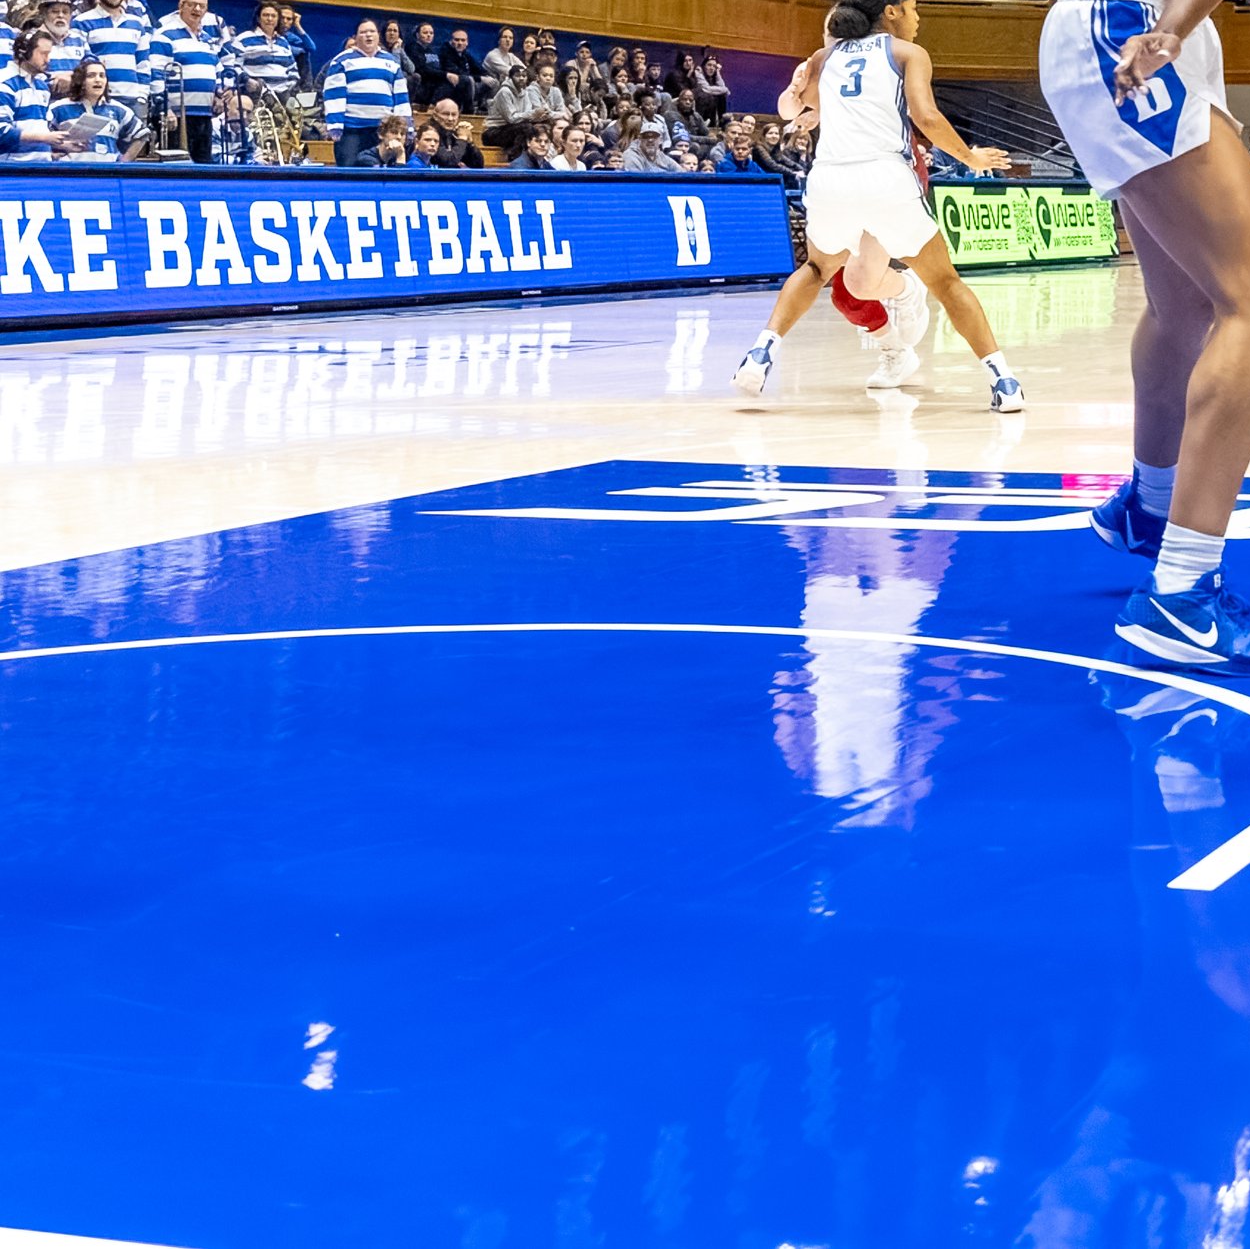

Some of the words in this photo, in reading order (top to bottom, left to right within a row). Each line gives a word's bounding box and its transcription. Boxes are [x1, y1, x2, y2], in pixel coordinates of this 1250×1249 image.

[840, 58, 867, 97] 3
[962, 203, 1011, 230] wave
[1052, 203, 1095, 228] wave
[0, 200, 119, 295] KE
[138, 198, 573, 291] BASKETBALL
